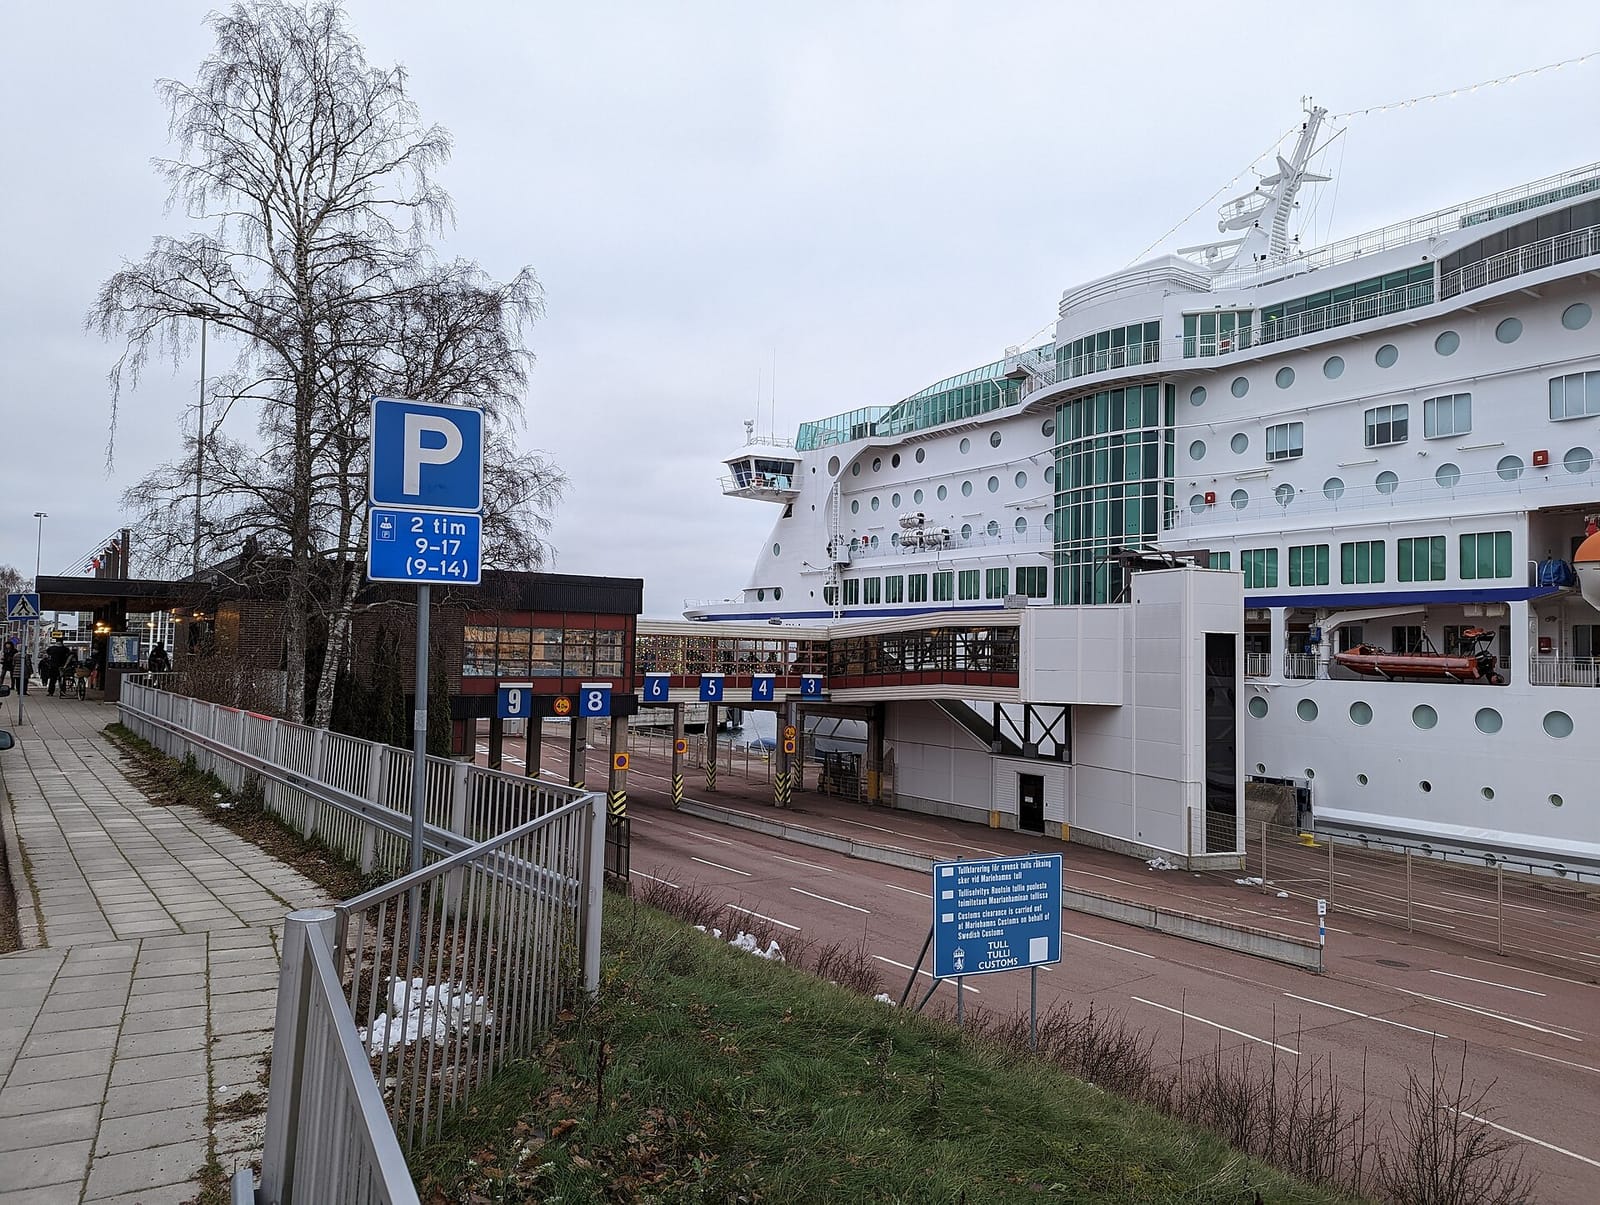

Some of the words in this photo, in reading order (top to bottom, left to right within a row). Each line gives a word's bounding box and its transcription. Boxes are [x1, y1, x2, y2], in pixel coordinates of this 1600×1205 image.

[403, 413, 463, 496] P
[411, 517, 424, 533] 2
[433, 518, 466, 536] tim
[415, 538, 461, 556] 9-17
[406, 557, 469, 578] (9-14)
[652, 679, 661, 696] 6
[708, 679, 716, 696] 5
[758, 679, 768, 696] 4
[807, 679, 815, 695] 3
[508, 688, 521, 714] 9
[587, 691, 603, 712] 8
[1001, 862, 1019, 871] svensk
[1020, 861, 1032, 869] tulls
[958, 876, 969, 885] sker
[980, 873, 1011, 882] Mariehamns
[1013, 871, 1022, 880] tull
[1030, 892, 1048, 900] tullissa
[958, 912, 981, 920] Customs
[982, 909, 1007, 917] clearance
[1008, 907, 1014, 915] is
[1015, 905, 1033, 914] carried
[1033, 904, 1042, 912] out
[958, 922, 964, 930] at
[965, 920, 996, 929] Mariehamns
[997, 917, 1019, 926] Customs
[1028, 913, 1044, 922] behalf
[1044, 912, 1050, 920] of
[958, 930, 980, 940] Swedish
[981, 928, 1004, 938] Customs
[988, 940, 1009, 950] TULL
[987, 949, 1010, 959] TULLI
[978, 957, 1018, 970] CUSTOMS
